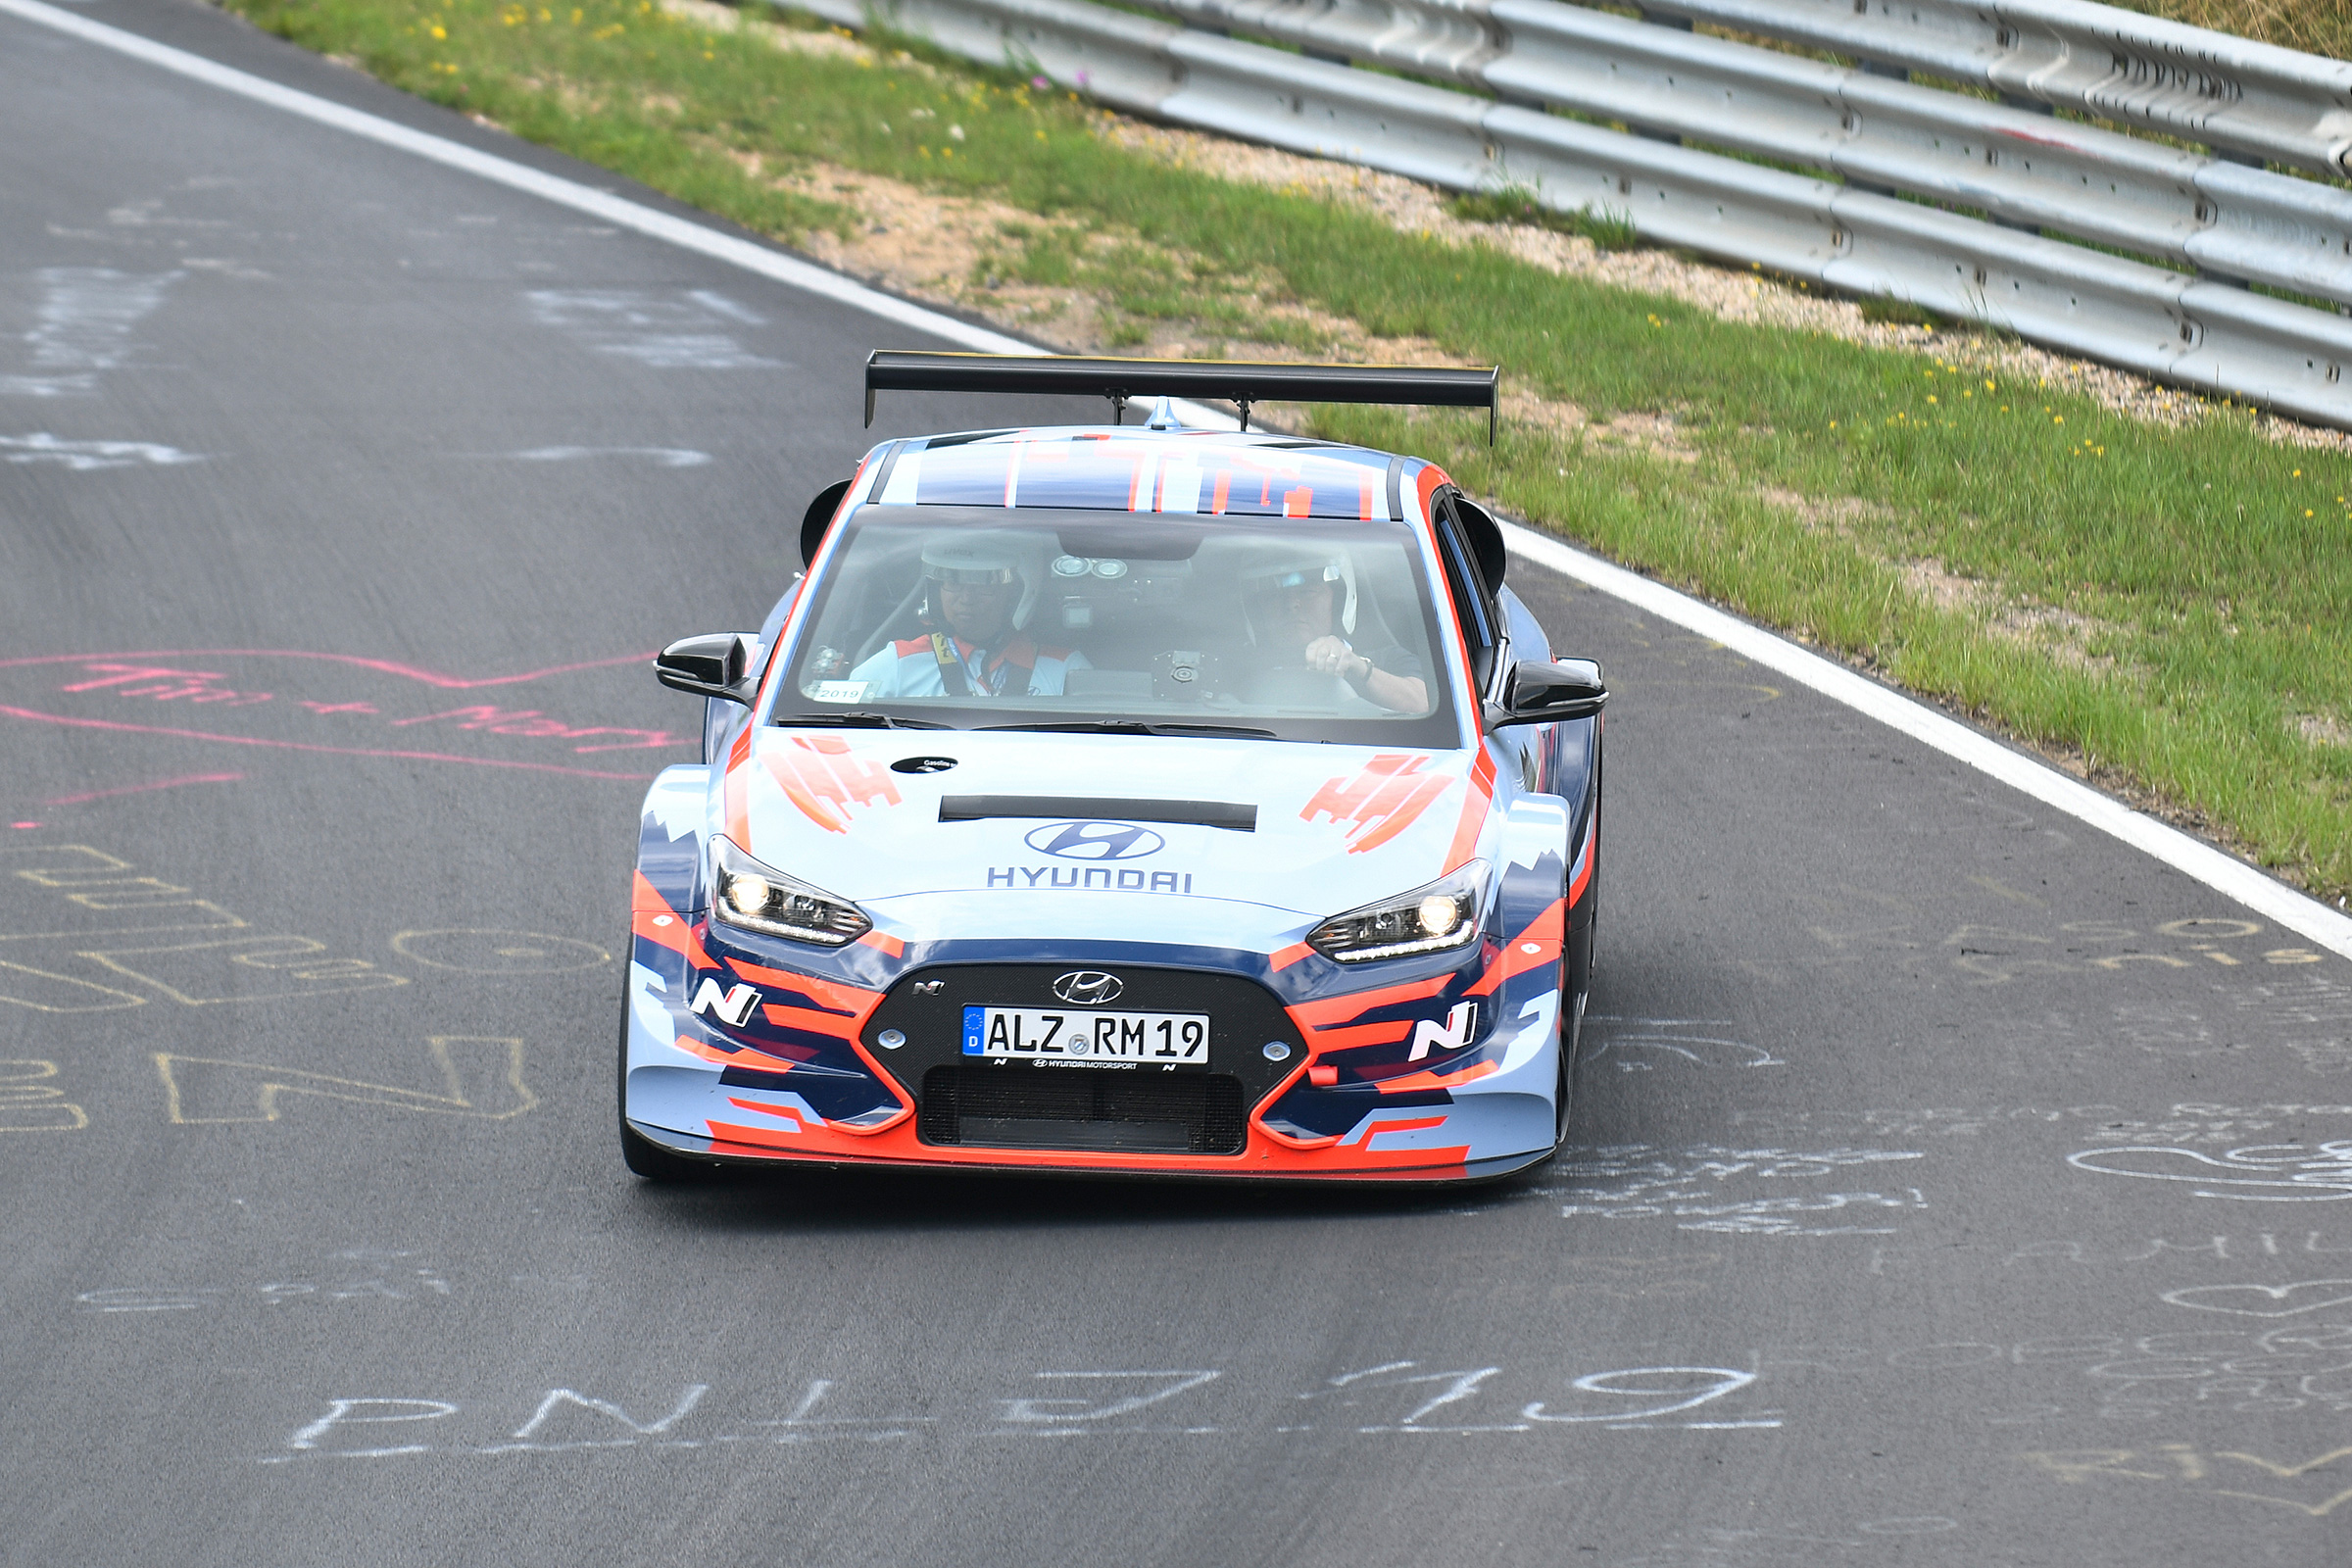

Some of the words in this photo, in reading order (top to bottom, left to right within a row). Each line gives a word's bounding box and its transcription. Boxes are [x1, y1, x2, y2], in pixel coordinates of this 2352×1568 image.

[819, 690, 859, 699] 2019
[987, 866, 1193, 894] HYUNDAI
[987, 1013, 1064, 1053] ALZ
[1094, 1017, 1146, 1055] RM
[1155, 1019, 1204, 1057] 19
